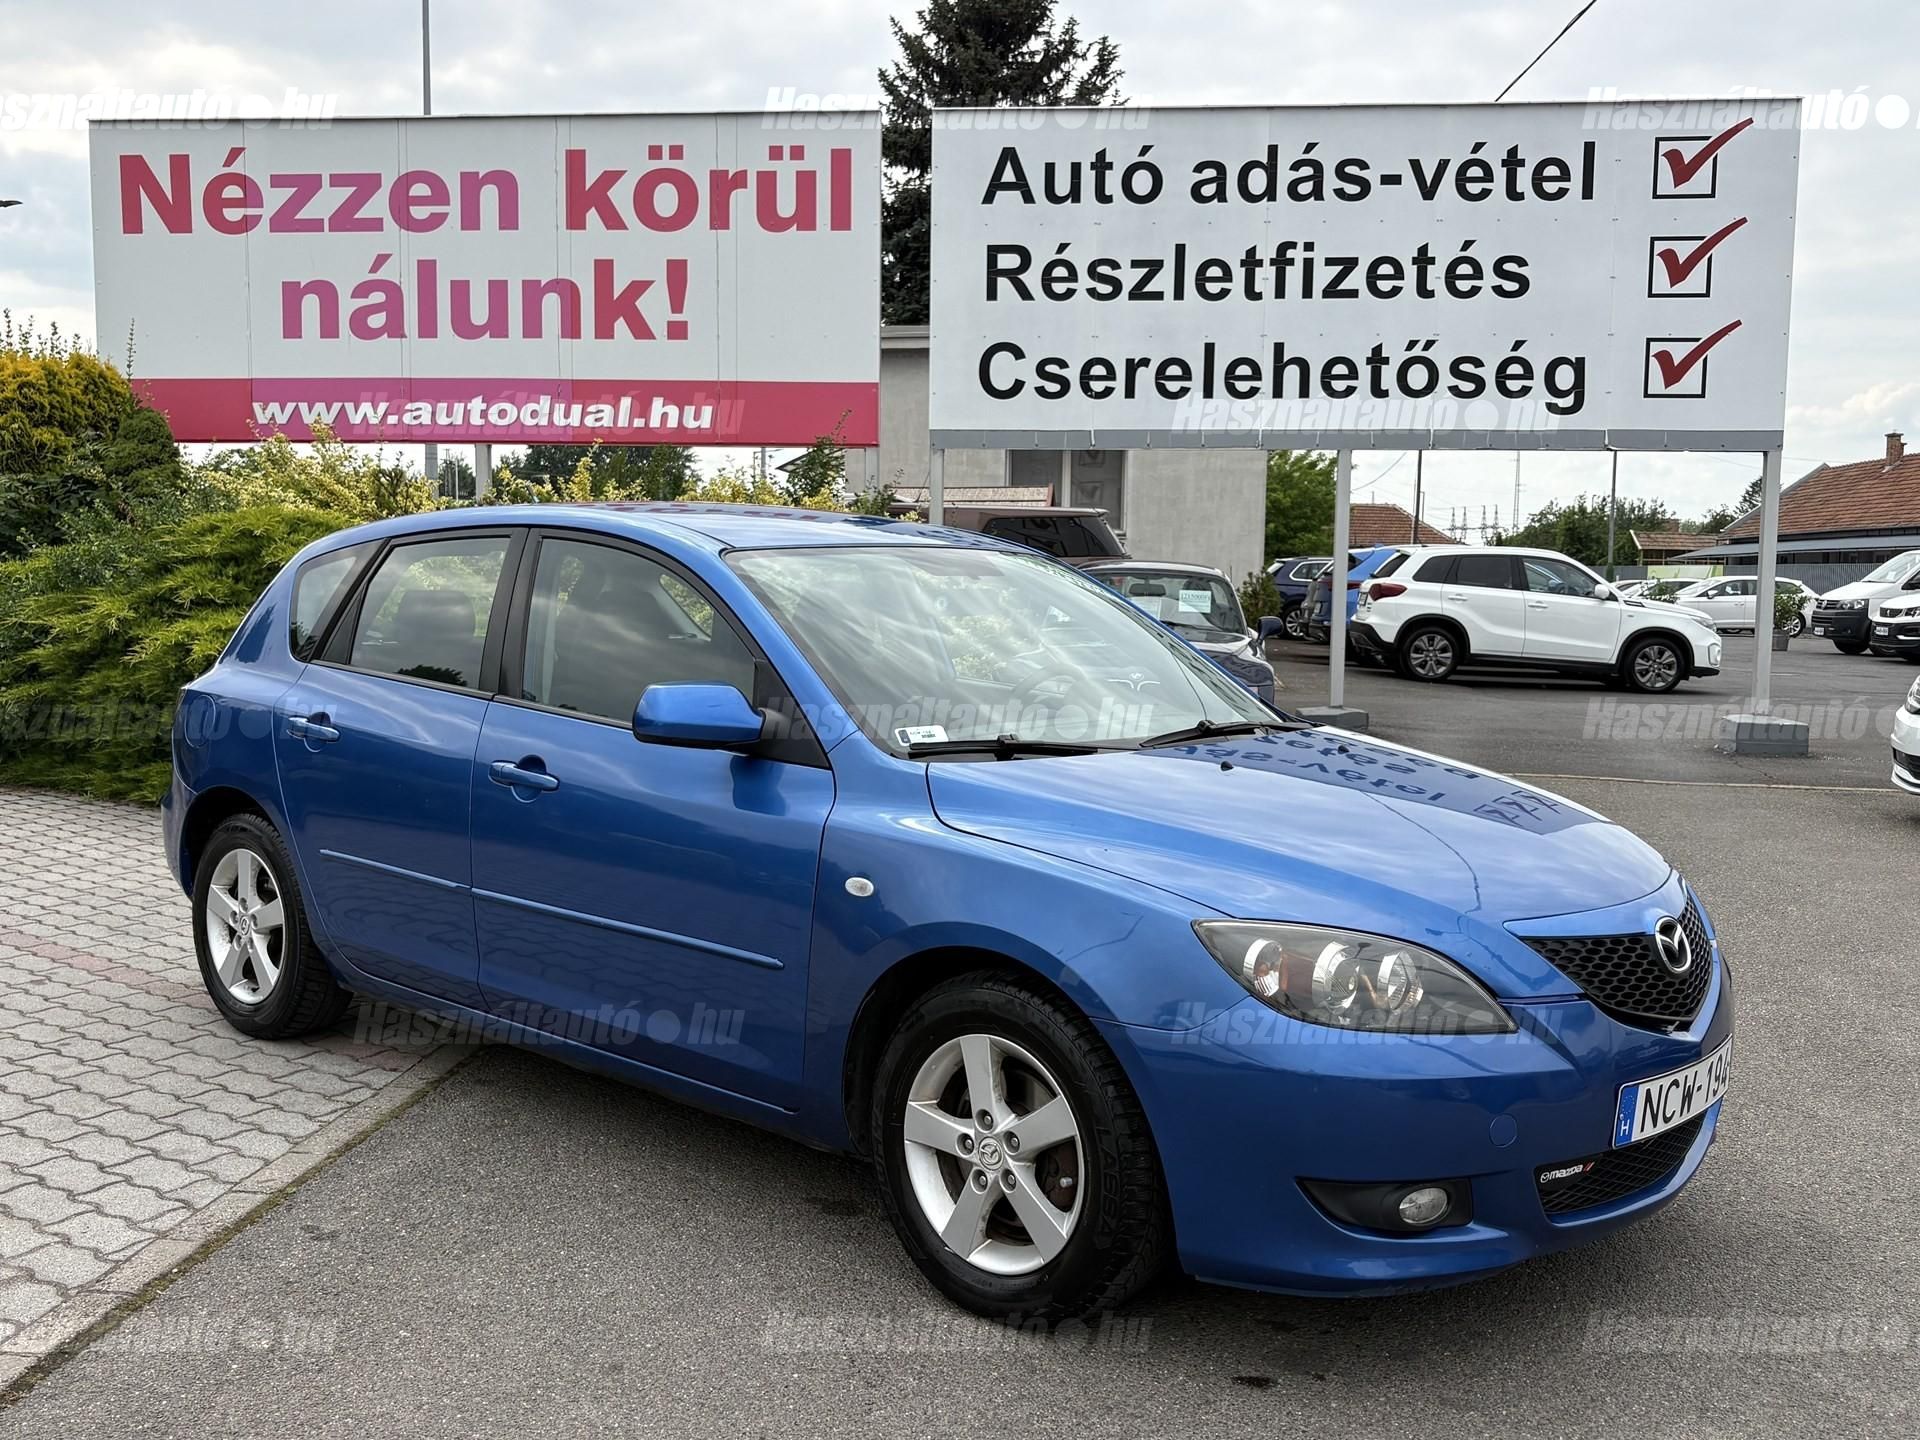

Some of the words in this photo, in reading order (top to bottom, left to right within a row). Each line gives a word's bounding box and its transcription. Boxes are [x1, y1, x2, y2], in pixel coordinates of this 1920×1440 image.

[121, 147, 518, 235] Nézzen
[566, 145, 852, 232] körül
[980, 144, 1164, 205] Autó
[1190, 141, 1596, 203] adás-vétel
[283, 256, 688, 341] nálunk!
[985, 240, 1531, 302] Részletfizetés
[251, 394, 714, 431] www.autodual.hu
[978, 339, 1587, 416] Cserelehetőség
[1620, 1119, 1630, 1137] H
[1640, 1046, 1730, 1134] NCW-194
